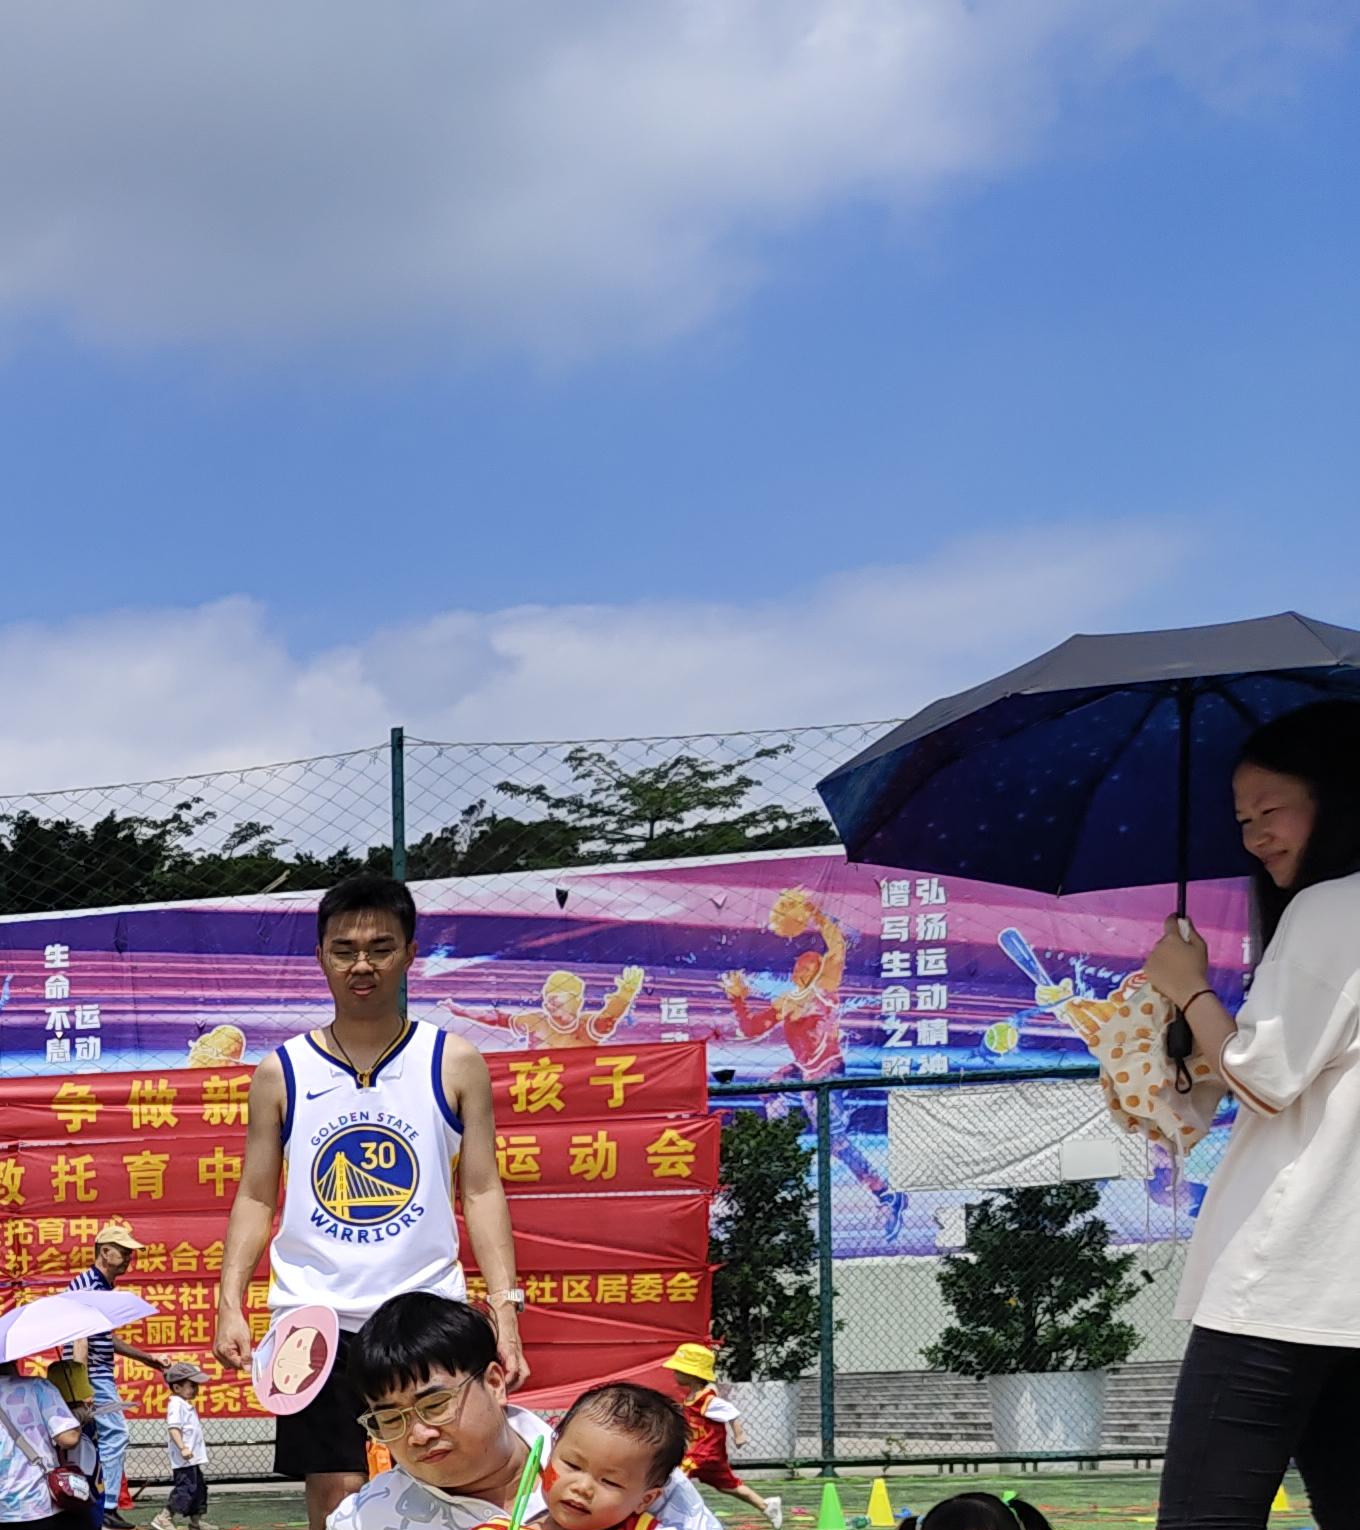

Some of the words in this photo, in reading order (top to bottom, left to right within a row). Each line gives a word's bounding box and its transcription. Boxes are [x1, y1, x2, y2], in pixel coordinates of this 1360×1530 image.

[44, 943, 71, 1063] 生命不息
[915, 877, 948, 1075] 弘扬运动精神
[74, 1003, 101, 1074] 运动
[508, 1055, 645, 1114] 孩子
[311, 1111, 370, 1146] GOLDEN
[376, 1112, 420, 1142] STATE
[360, 1141, 397, 1170] 30
[495, 1127, 697, 1182] 运动会
[310, 1202, 425, 1244] WARRIORS
